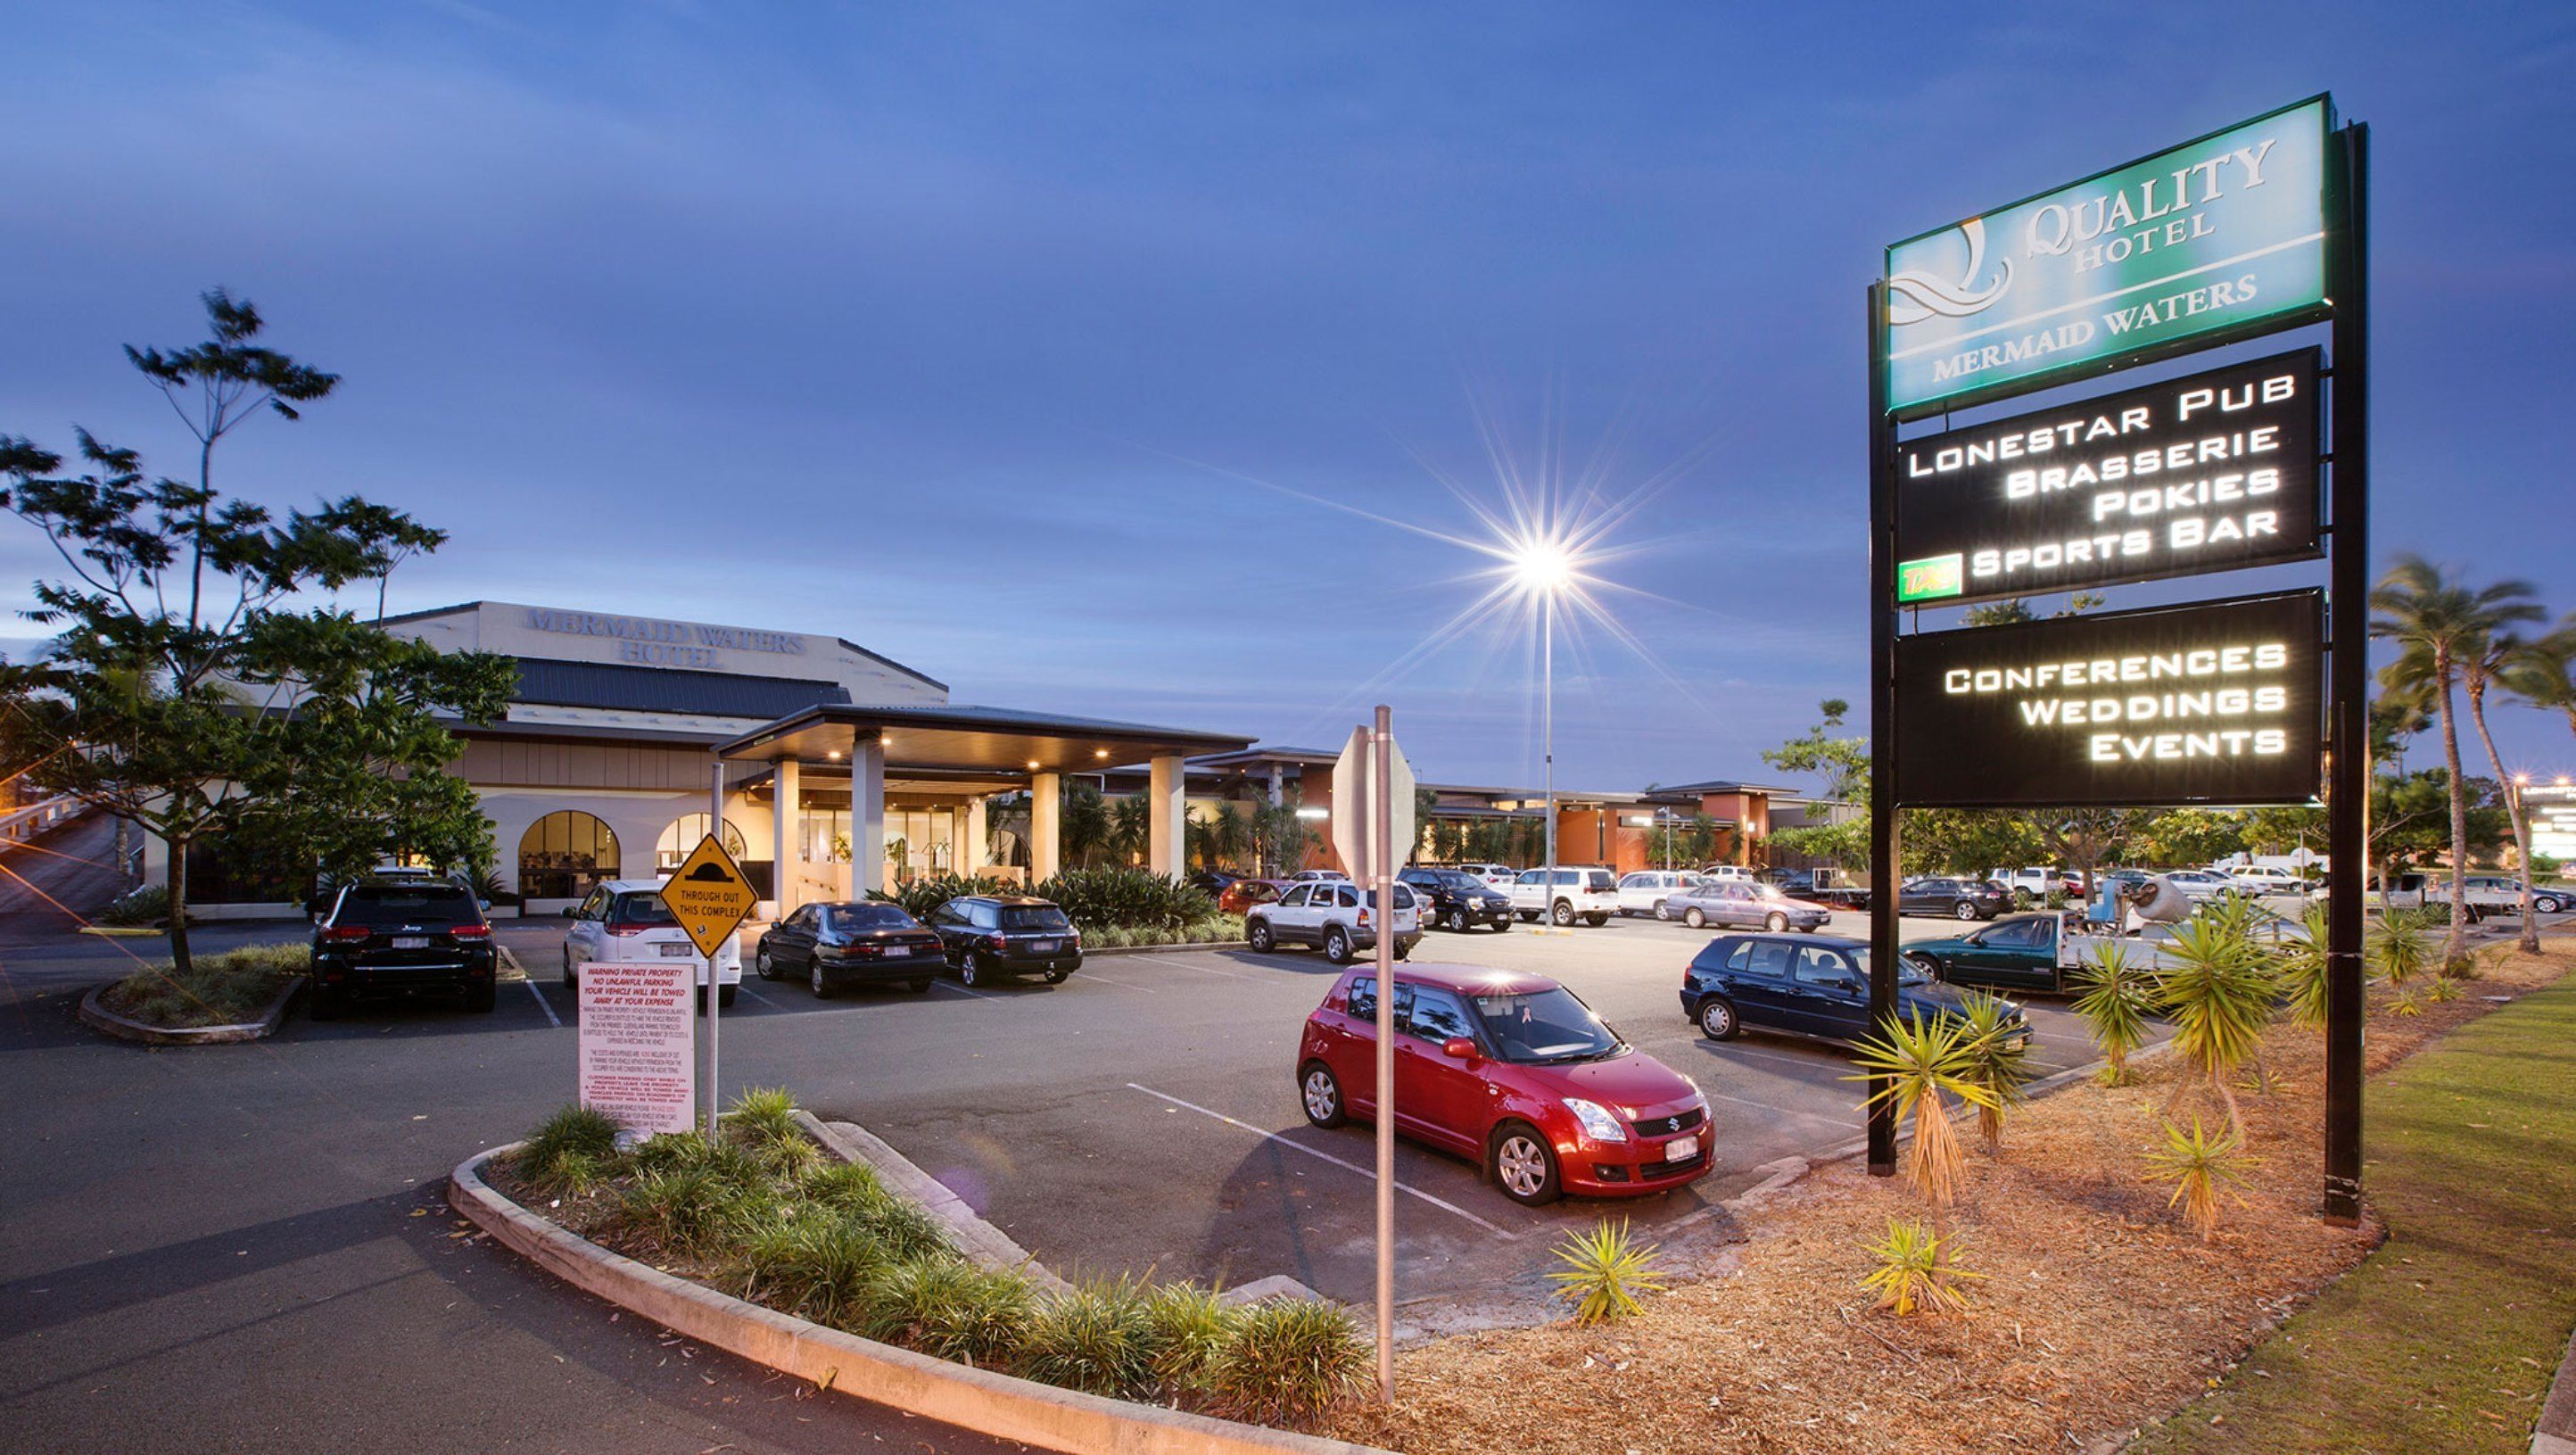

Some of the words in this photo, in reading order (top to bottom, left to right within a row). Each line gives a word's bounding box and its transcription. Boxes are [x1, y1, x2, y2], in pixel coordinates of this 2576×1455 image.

[2026, 139, 2275, 258] QUALITY
[2075, 212, 2216, 273] HOTEL
[1932, 321, 2095, 383] MERMAID
[2102, 274, 2258, 335] WATERS
[1910, 408, 2151, 478] LONESTAR
[2179, 374, 2294, 421] PUB
[2007, 426, 2280, 500] BRASSERIE
[2093, 469, 2280, 522] POKIES
[1972, 530, 2151, 578] SPORTS
[2170, 511, 2278, 550] BAR
[528, 608, 689, 643] MERMAID
[694, 626, 805, 655] WATERS
[622, 641, 724, 669] HOTEL
[1944, 643, 2287, 694] CONFERENCES
[2019, 687, 2287, 726] WEDDINGS
[2091, 729, 2287, 763] EVENTS
[680, 905, 698, 915] THIS
[702, 906, 740, 918] COMPLEX
[681, 890, 720, 902] THROUGH
[723, 892, 739, 903] OUT
[588, 968, 619, 976] WARNING
[648, 969, 683, 977] PROPERTY
[605, 988, 632, 996] VEHICLE
[643, 979, 674, 987] PARKING
[644, 998, 675, 1006] EXPENSE
